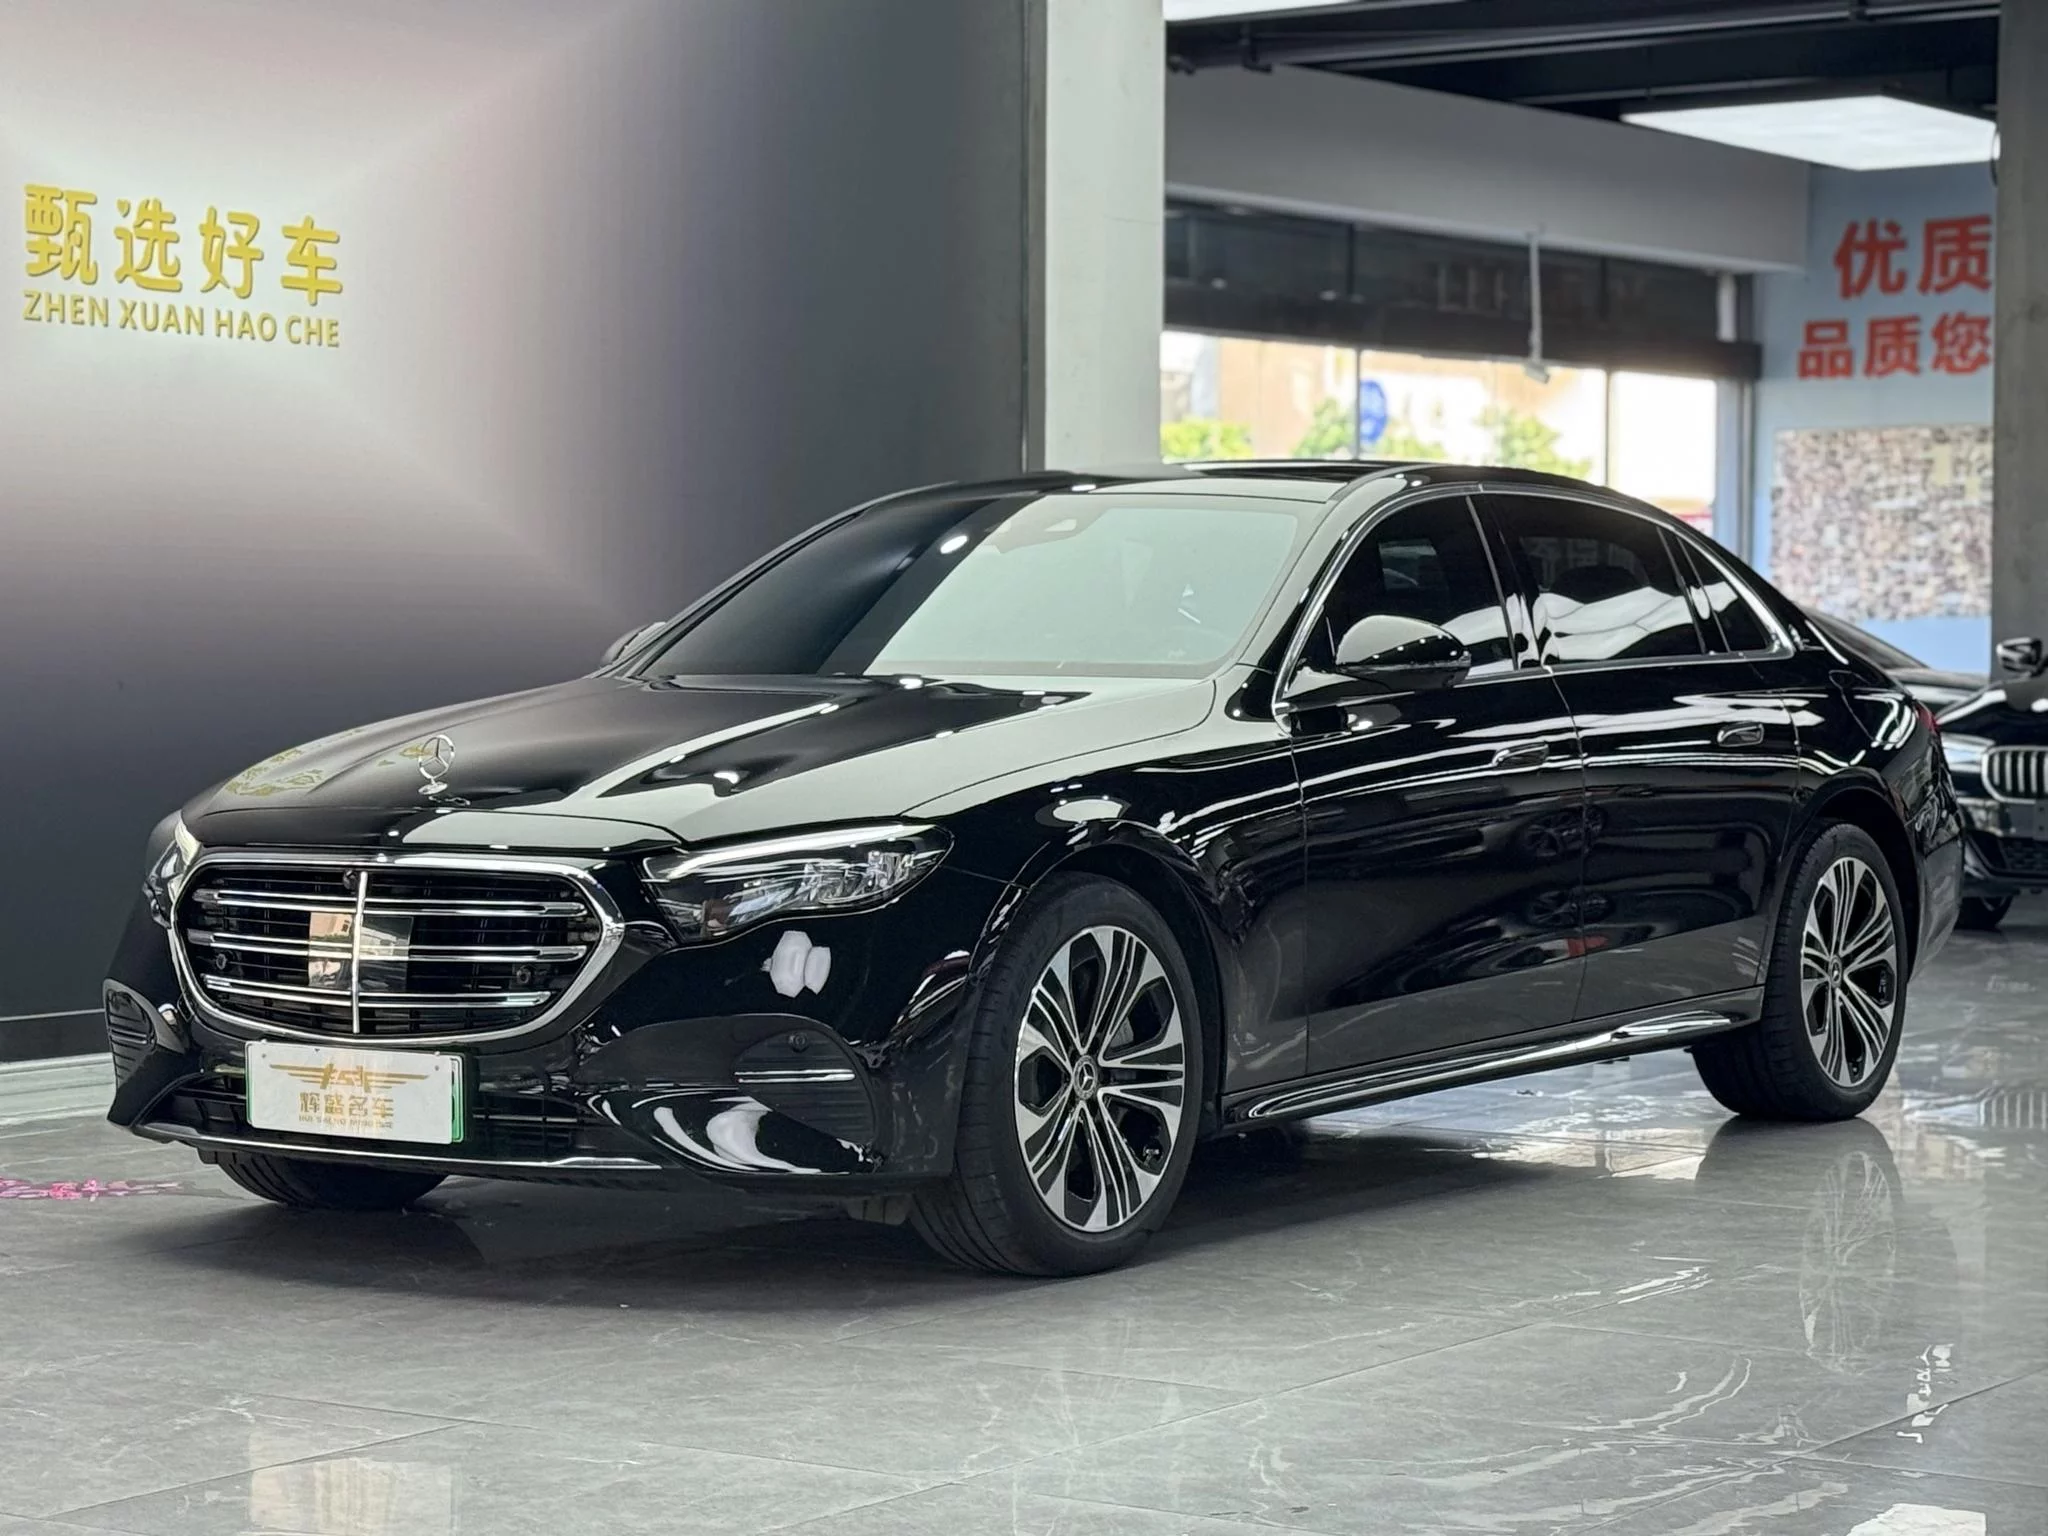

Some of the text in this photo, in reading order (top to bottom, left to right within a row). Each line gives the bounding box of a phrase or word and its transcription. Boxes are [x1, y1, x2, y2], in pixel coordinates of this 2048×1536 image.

[24, 184, 343, 306] 甄选好车
[1833, 214, 1992, 300] 优质
[22, 290, 340, 348] ZHEN XUAN HAO CHE
[1798, 311, 1992, 379] 品质您
